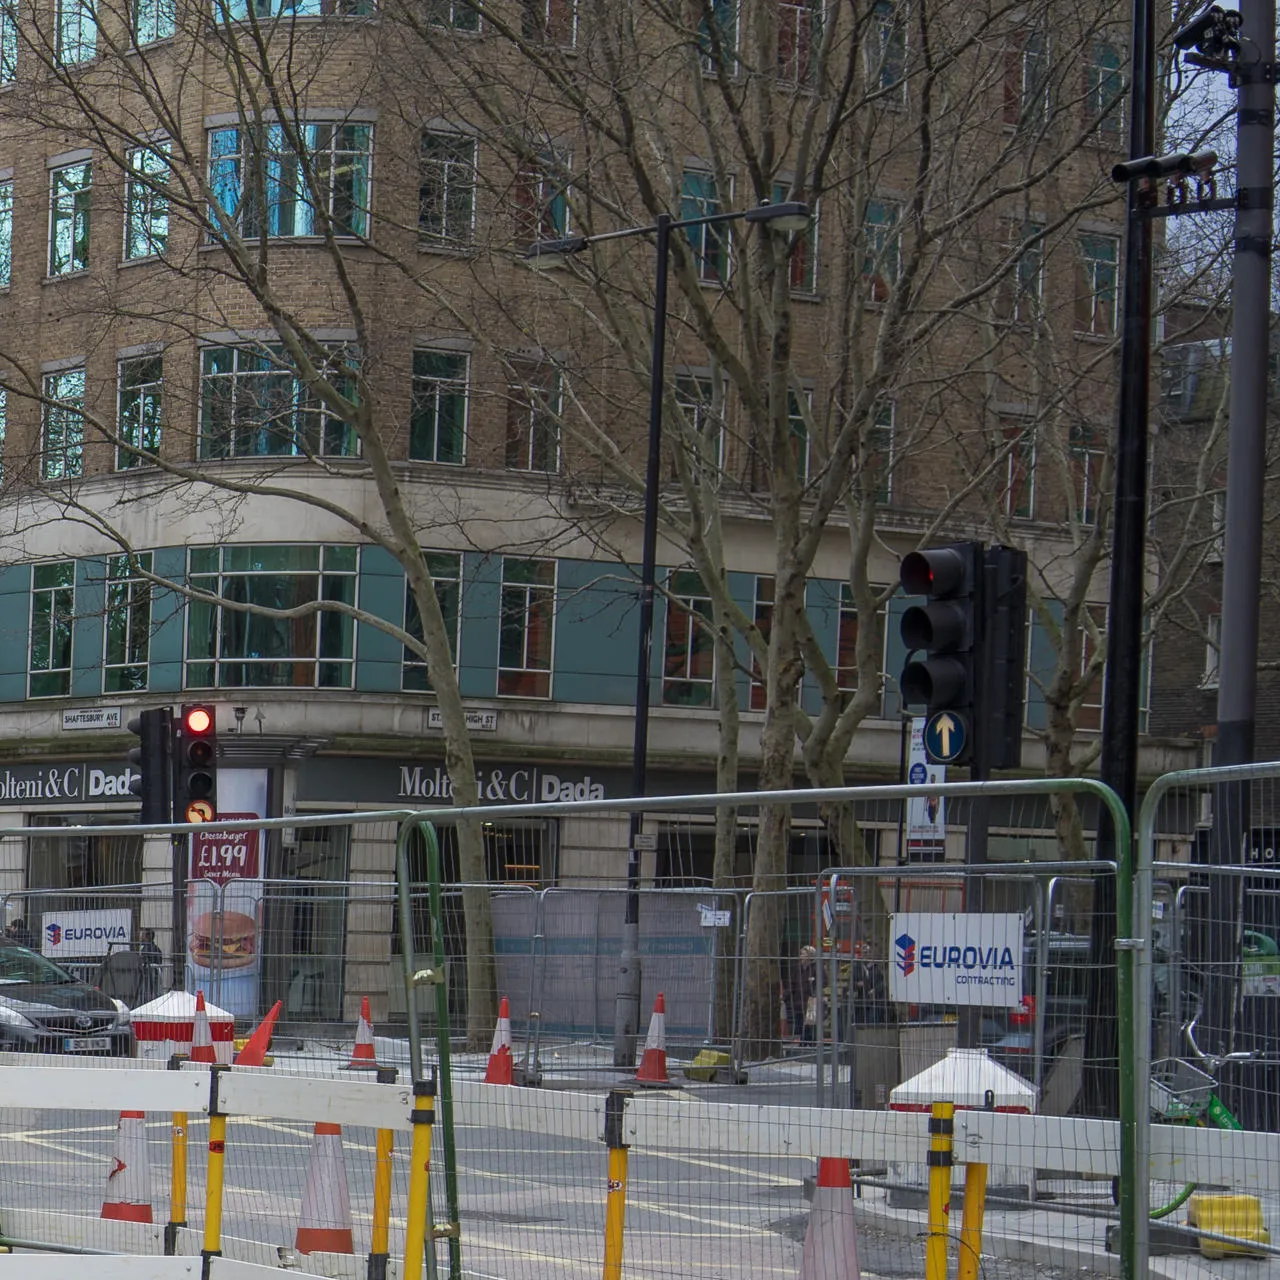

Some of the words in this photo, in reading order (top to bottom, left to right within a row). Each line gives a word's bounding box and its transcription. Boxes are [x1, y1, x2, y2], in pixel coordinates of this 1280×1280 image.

[64, 713, 104, 724] SHAFTESBURY
[106, 712, 118, 721] AVE
[466, 715, 483, 724] HIGH
[541, 774, 604, 801] Dada
[200, 831, 248, 843] Cheeseburger
[199, 844, 247, 867] £1.99
[65, 926, 127, 940] EUROVIA
[920, 946, 1015, 970] EUROVIA
